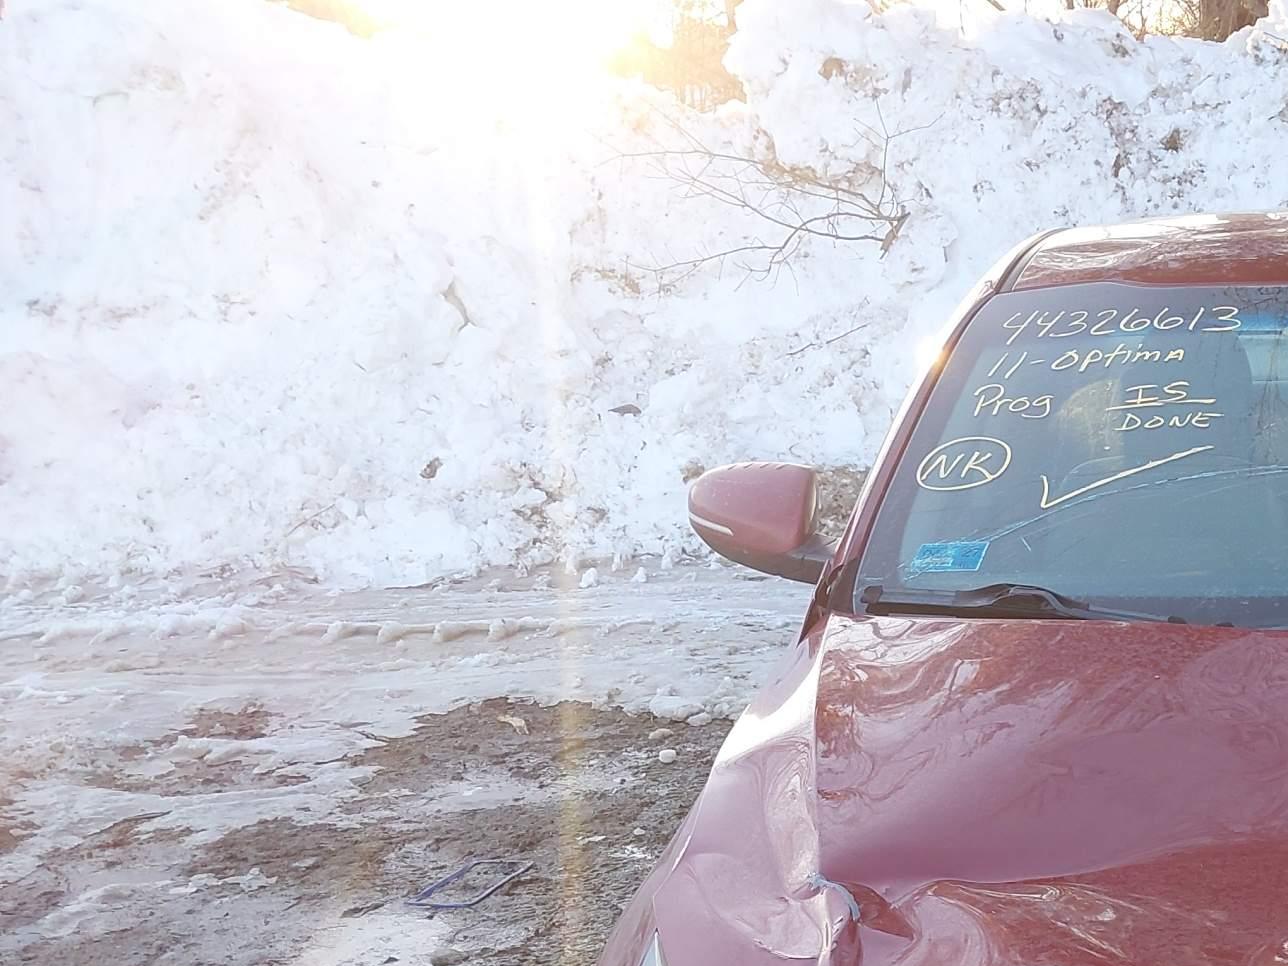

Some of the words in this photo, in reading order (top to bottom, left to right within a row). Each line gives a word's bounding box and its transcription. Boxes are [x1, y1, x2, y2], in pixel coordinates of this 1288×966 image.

[1002, 306, 1243, 346] 44326613
[973, 383, 1055, 419] Prog
[1124, 380, 1191, 404] IS
[1112, 411, 1225, 432] DONE
[920, 450, 994, 481] NK
